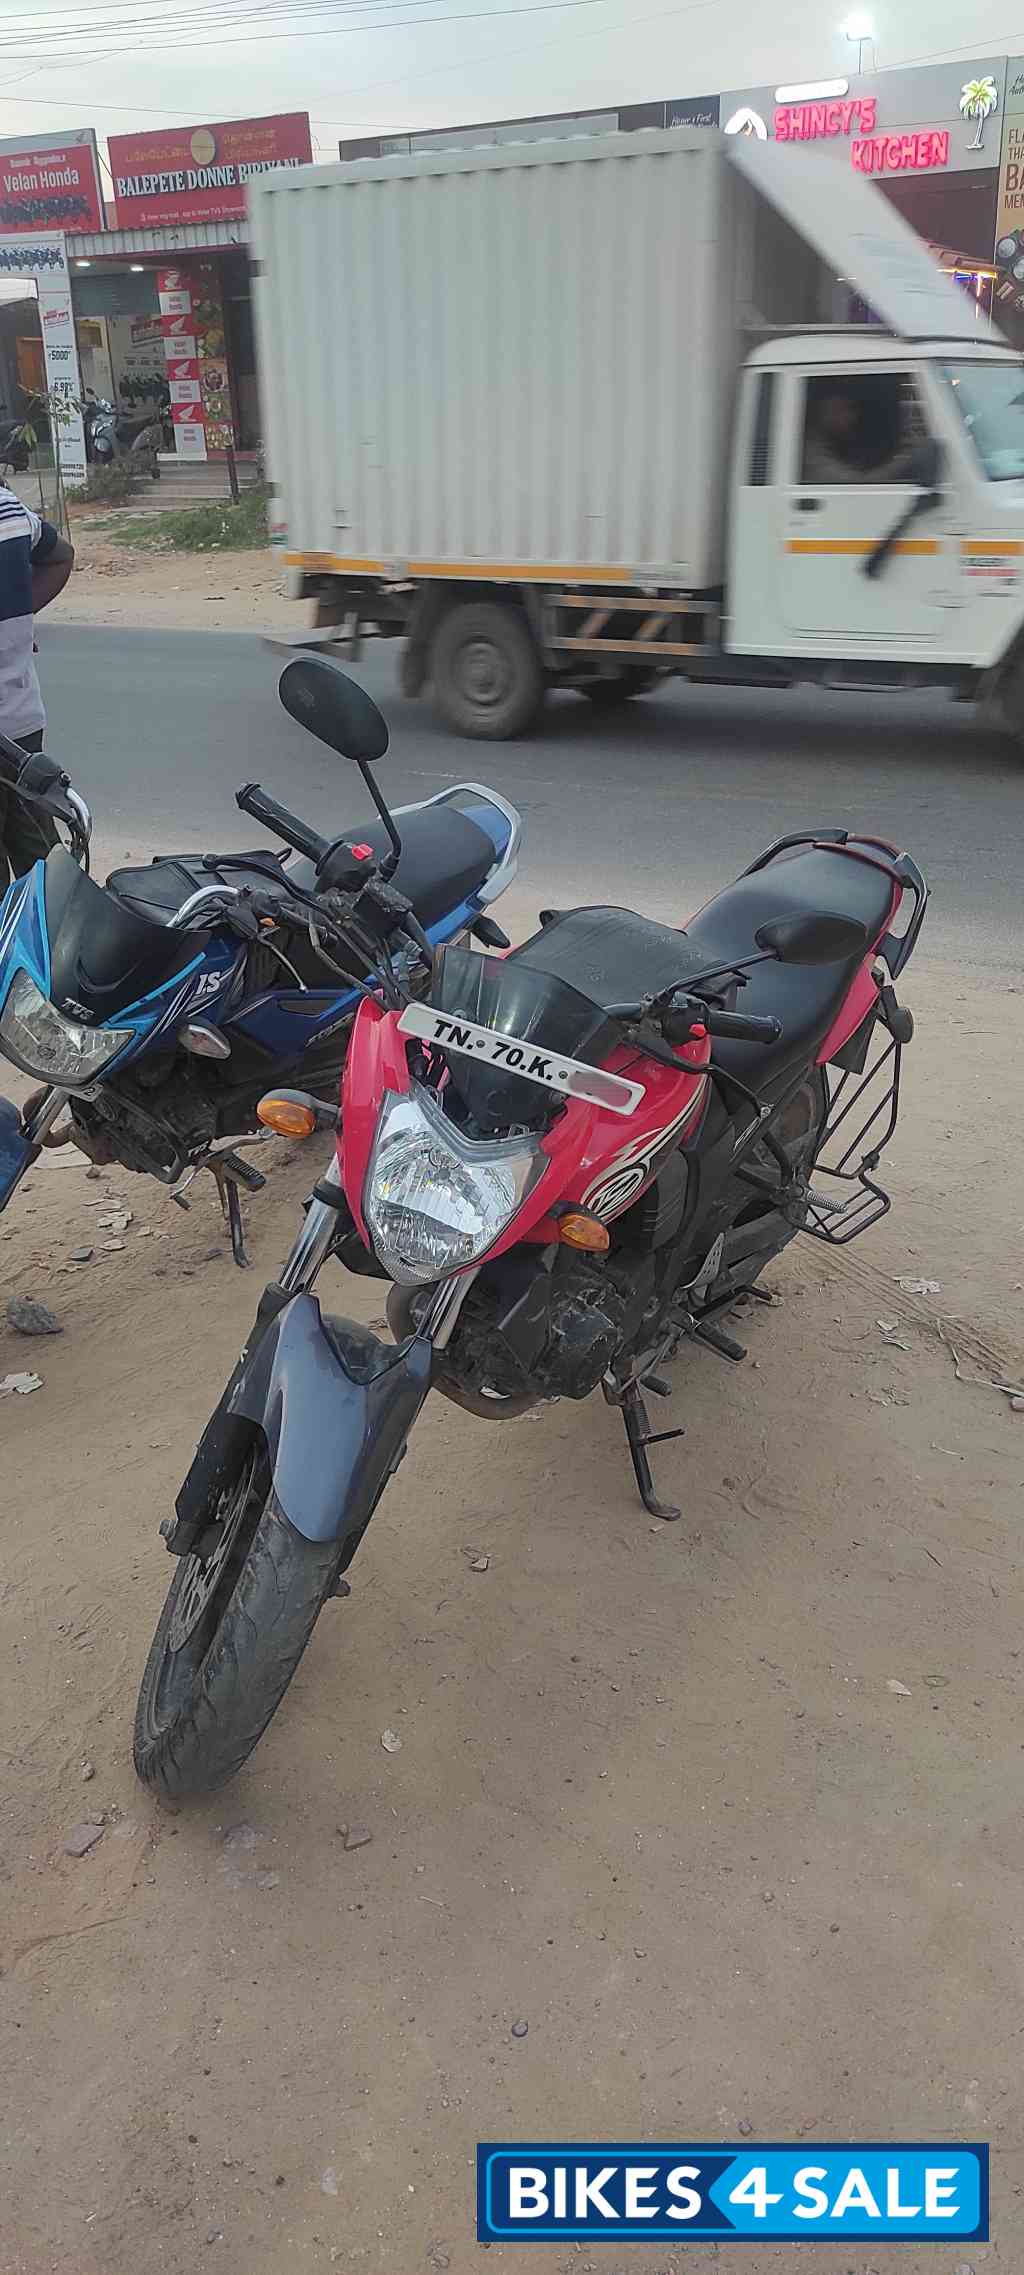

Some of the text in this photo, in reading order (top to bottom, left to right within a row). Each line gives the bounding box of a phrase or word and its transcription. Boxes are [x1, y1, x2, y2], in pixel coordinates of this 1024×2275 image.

[774, 97, 877, 142] SHINCY'S
[852, 131, 950, 174] KITCHEN
[3, 167, 80, 192] Velan Honda
[116, 170, 185, 198] BALEPETE
[187, 165, 237, 190] DONNE
[61, 997, 96, 1021] TVS
[433, 1019, 554, 1081] TN. 70.K.
